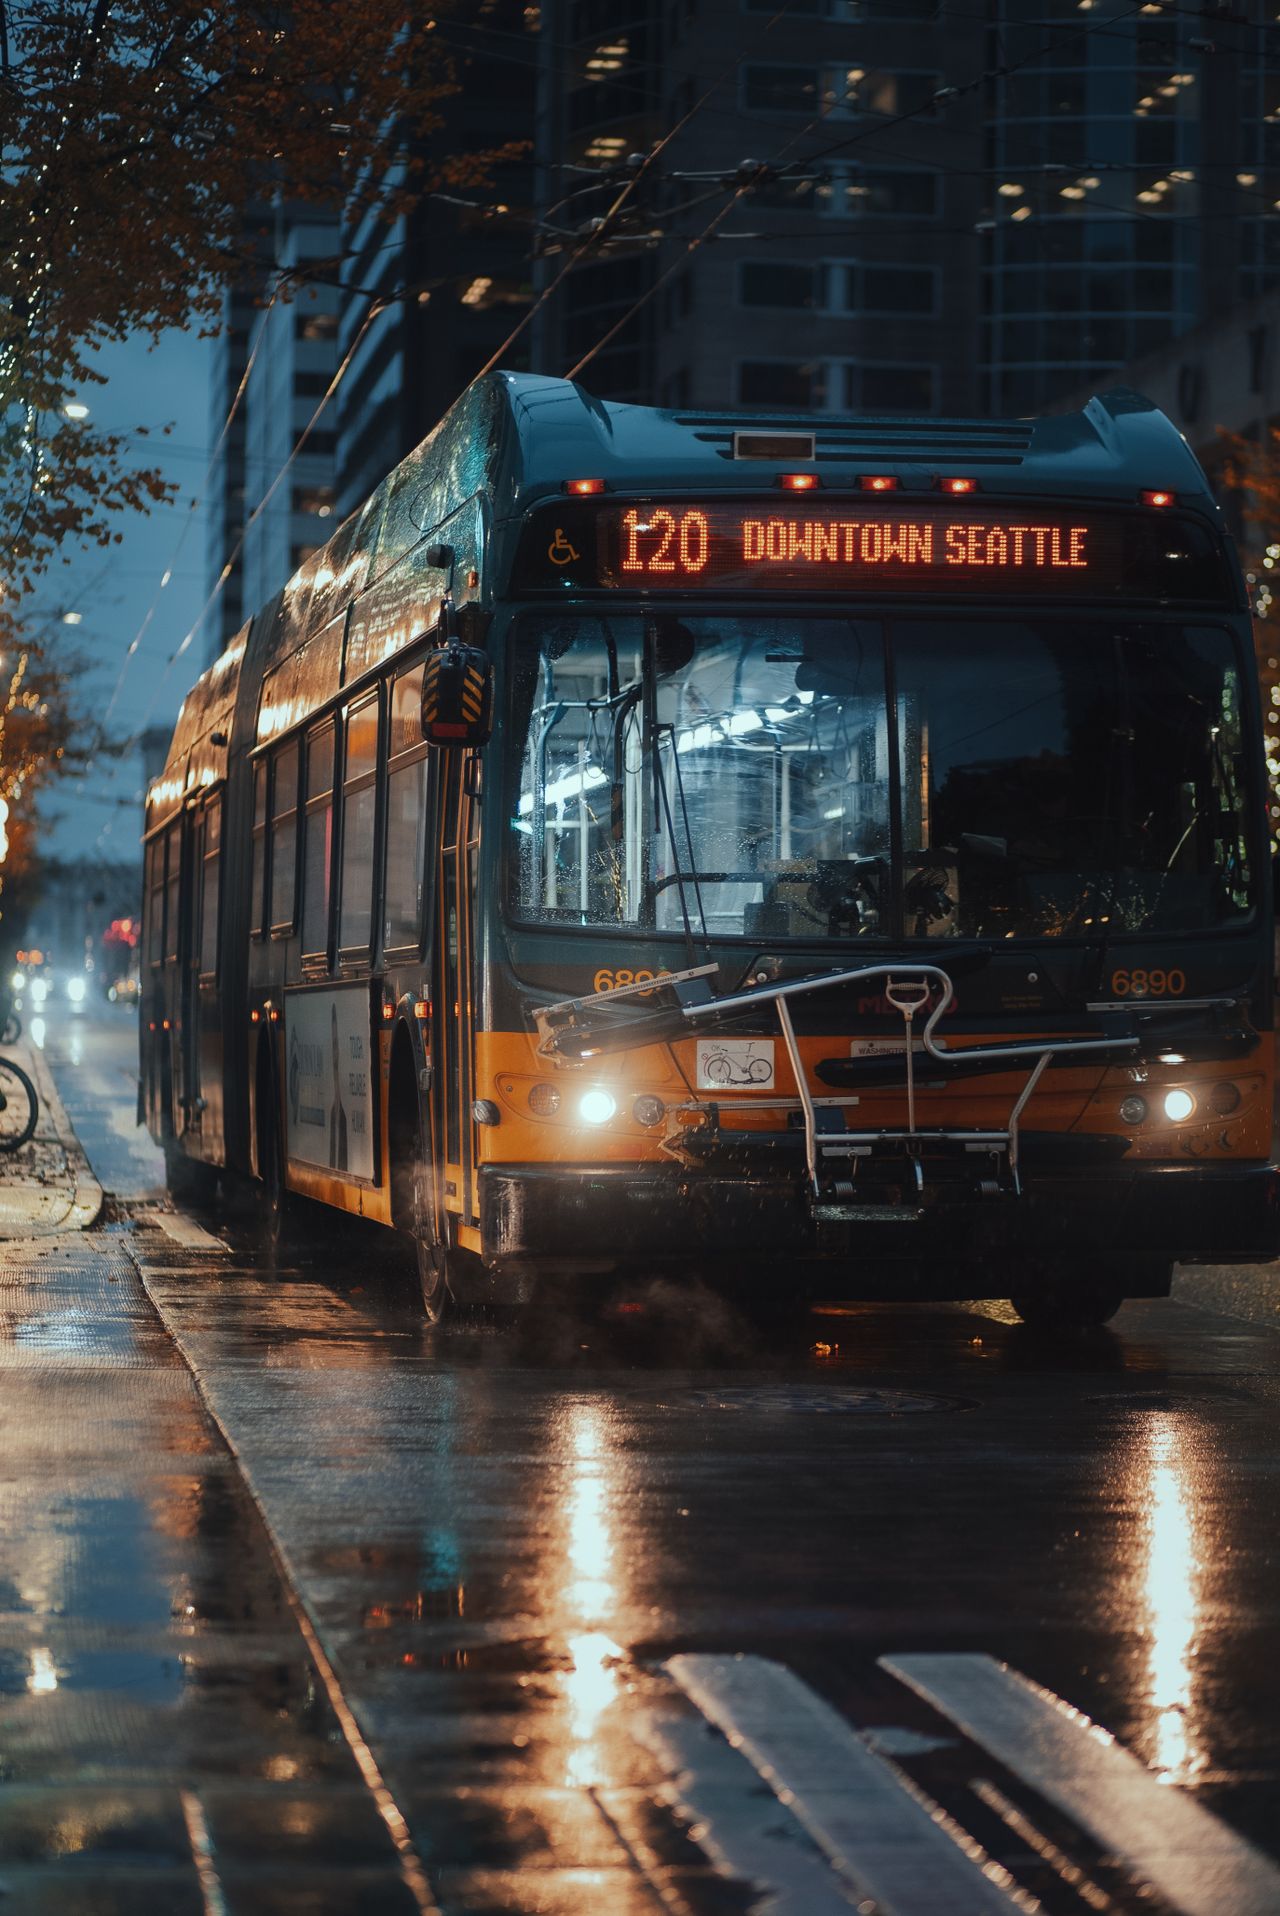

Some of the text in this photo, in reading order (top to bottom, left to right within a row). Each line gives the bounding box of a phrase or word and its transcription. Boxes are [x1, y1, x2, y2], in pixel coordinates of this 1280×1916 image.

[623, 508, 1088, 572] 120 DOWNTOWN SEATTLE
[1111, 969, 1186, 996] 6890
